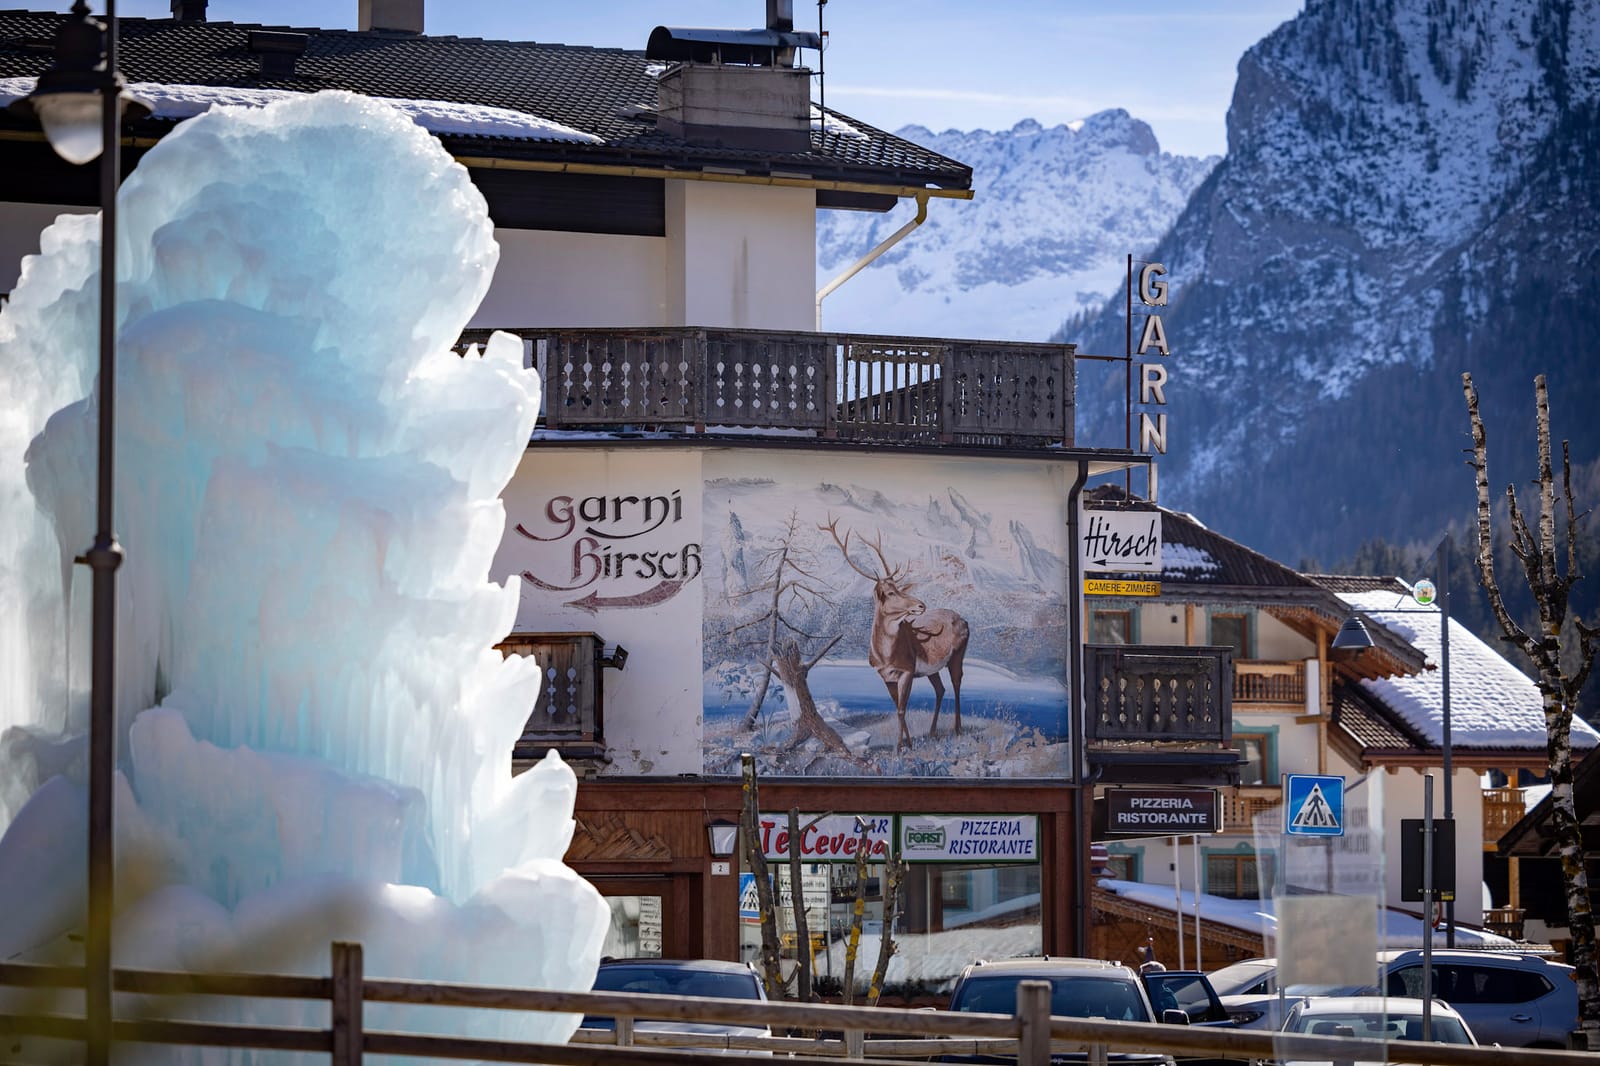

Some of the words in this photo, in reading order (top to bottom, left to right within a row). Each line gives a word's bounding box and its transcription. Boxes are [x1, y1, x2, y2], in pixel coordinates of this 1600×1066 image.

[1137, 263, 1170, 502] GARNI
[1083, 516, 1157, 558] Hirsch
[1131, 798, 1193, 808] PIZZERIA
[1118, 813, 1207, 824] RISTORANTE
[960, 821, 1021, 836] PIZZERIA
[909, 832, 942, 843] FORST
[949, 840, 1033, 855] RISTORANTE
